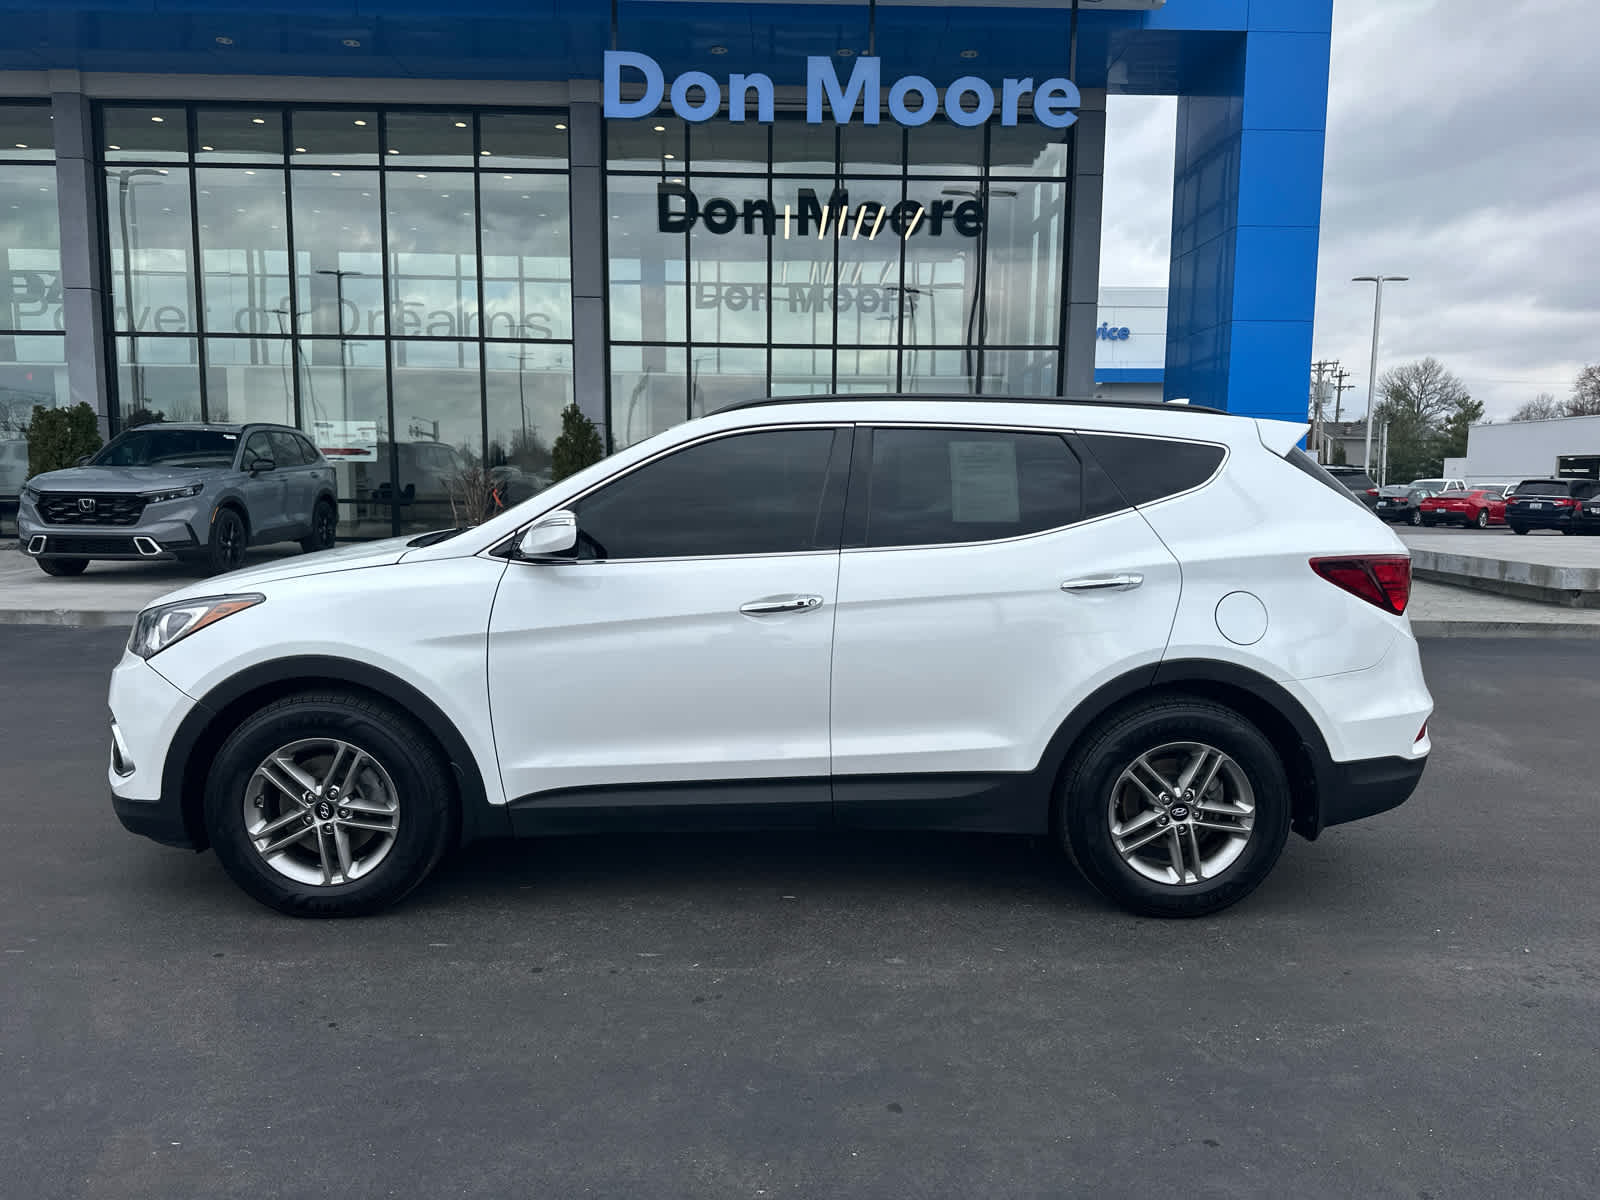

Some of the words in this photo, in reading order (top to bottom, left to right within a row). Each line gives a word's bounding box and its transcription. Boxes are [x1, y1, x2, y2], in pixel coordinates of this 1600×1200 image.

[603, 50, 775, 122] Don
[806, 55, 1081, 128] Moore
[657, 182, 777, 235] Don
[797, 188, 985, 238] Moore
